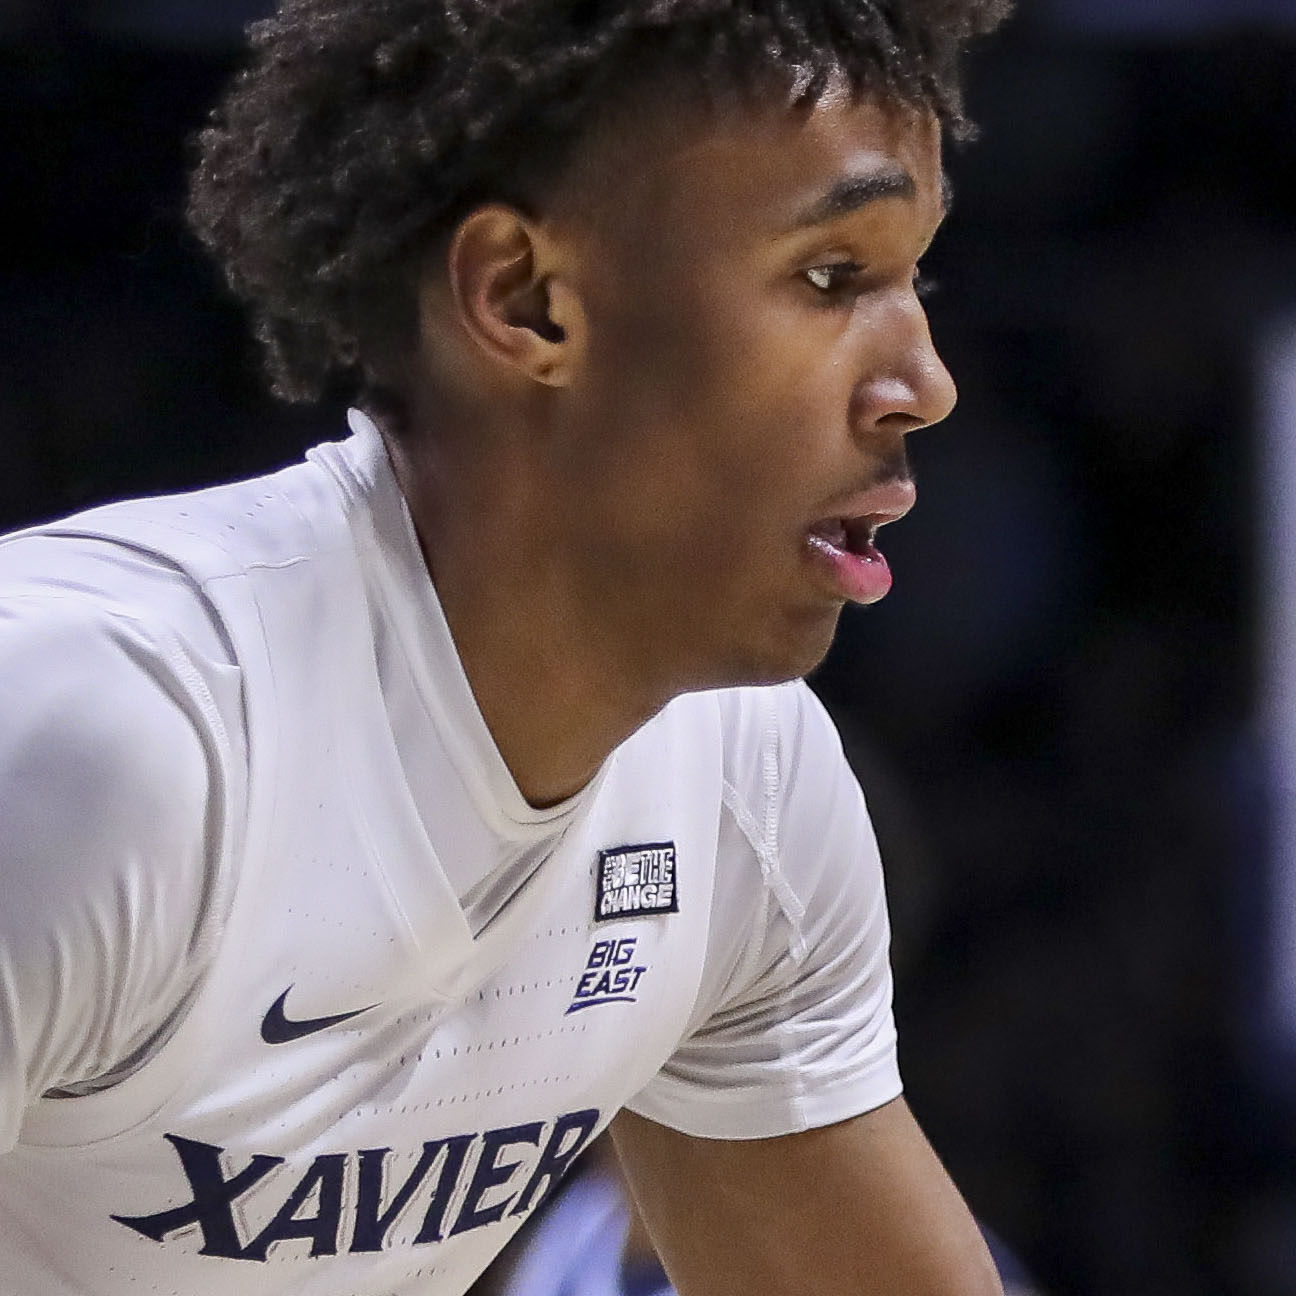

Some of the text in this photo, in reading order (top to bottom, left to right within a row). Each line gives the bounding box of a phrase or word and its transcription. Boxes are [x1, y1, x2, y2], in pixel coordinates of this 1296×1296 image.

[600, 883, 674, 916] CHANGE
[586, 937, 638, 970] BIG
[574, 966, 647, 998] EAST
[109, 1108, 600, 1263] XAVIER
